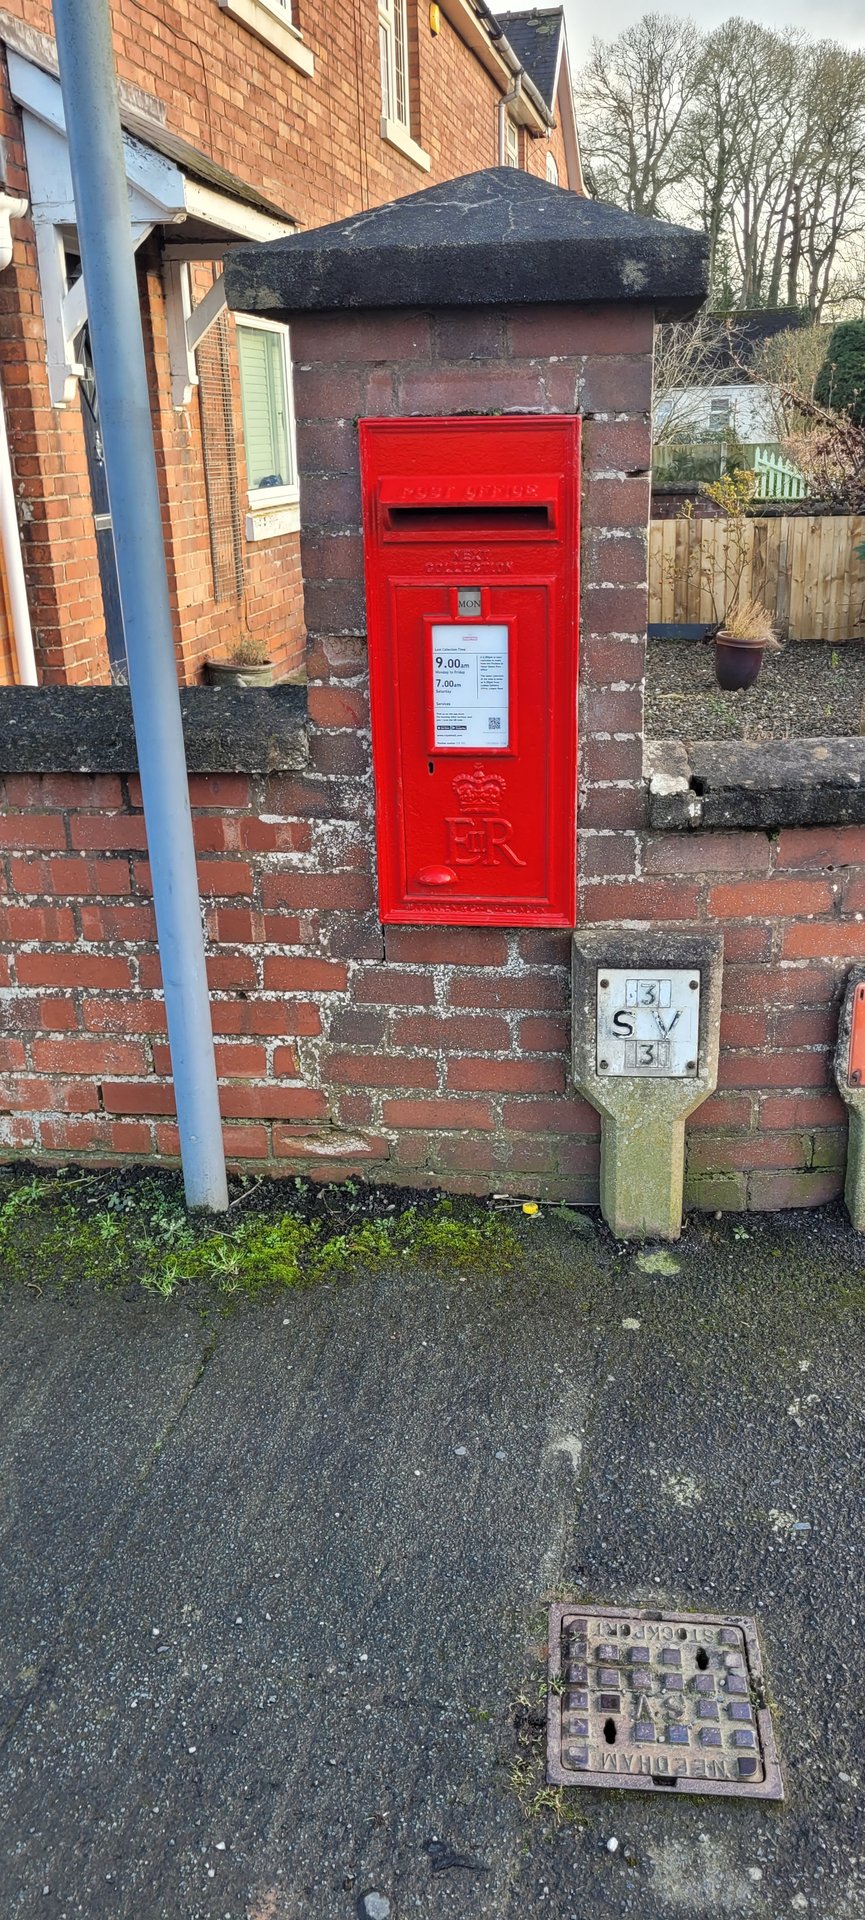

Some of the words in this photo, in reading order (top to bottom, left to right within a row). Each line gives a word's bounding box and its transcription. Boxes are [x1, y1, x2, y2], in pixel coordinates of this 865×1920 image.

[402, 486, 455, 499] POST
[466, 485, 539, 499] OFFICE
[458, 600, 481, 608] MON
[640, 983, 656, 1005] 3
[639, 1044, 654, 1065] 3
[596, 1622, 715, 1643] STOCKPORT
[601, 1752, 727, 1778] NEEDHAM
